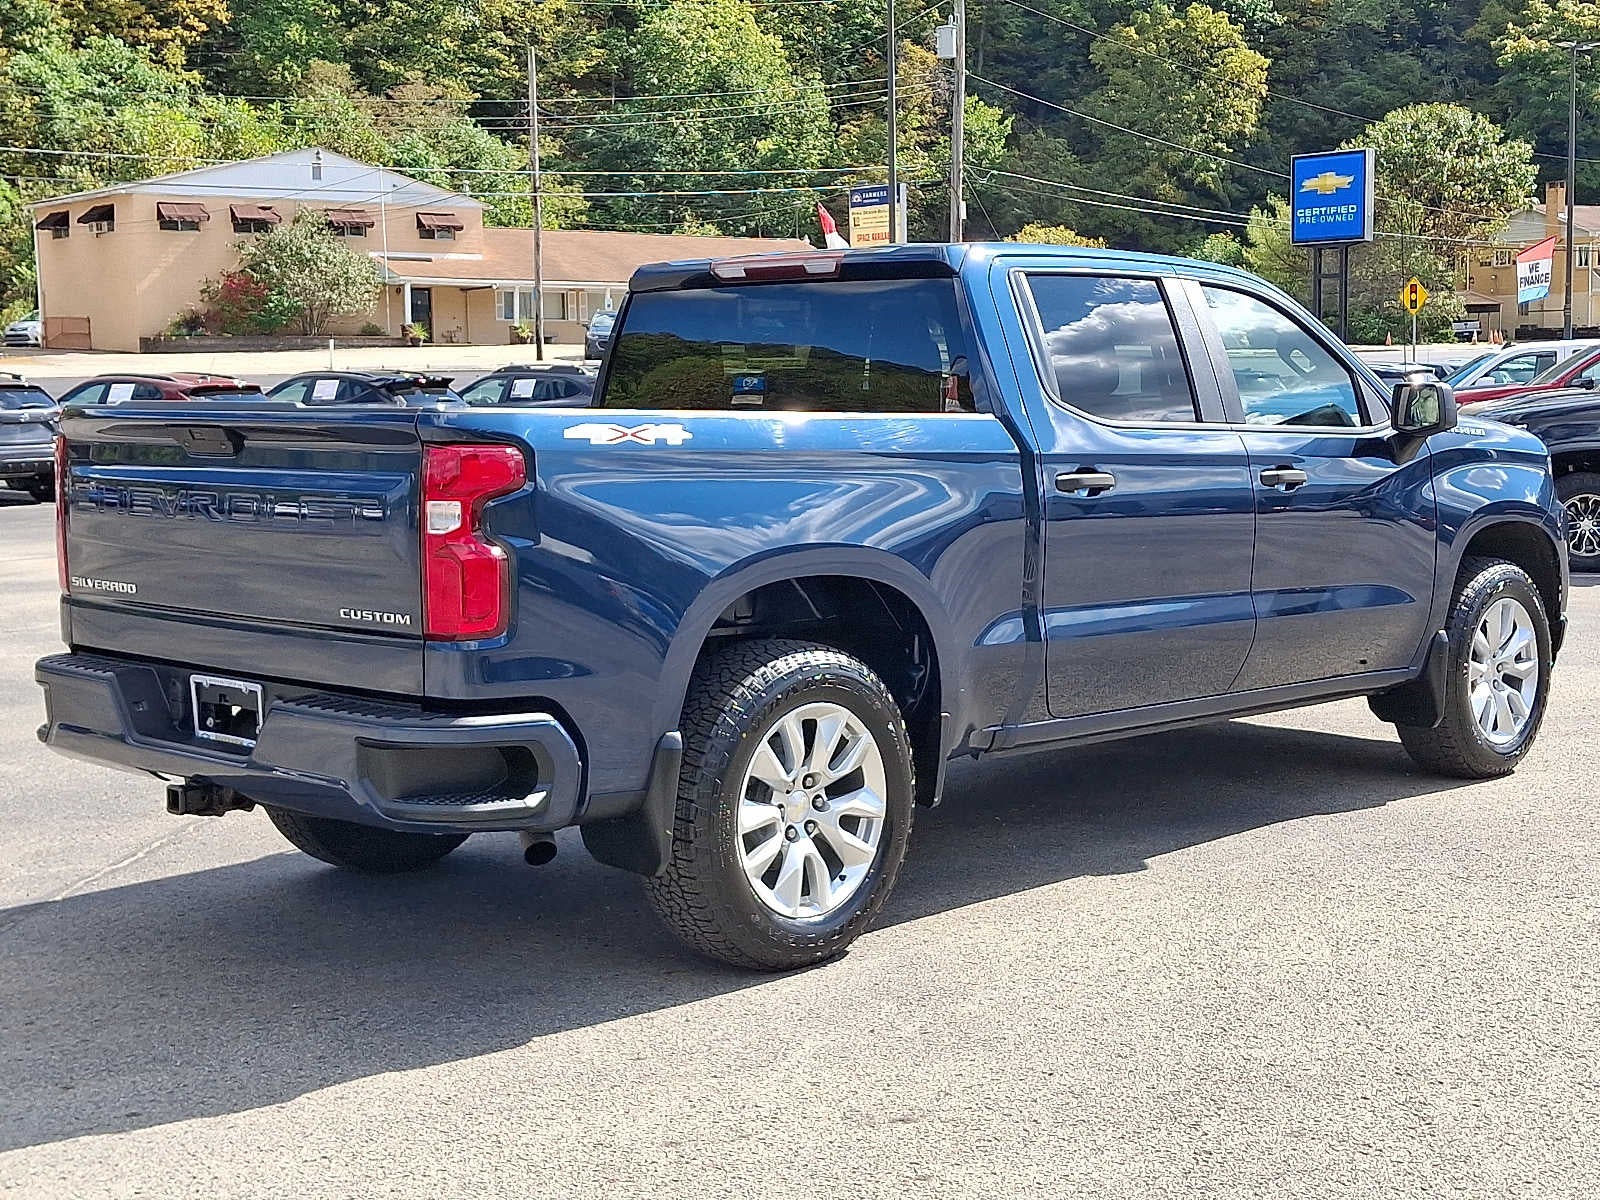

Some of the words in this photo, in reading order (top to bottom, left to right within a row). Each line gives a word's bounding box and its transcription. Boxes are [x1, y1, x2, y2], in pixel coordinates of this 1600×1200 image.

[1296, 204, 1357, 217] CERTIFIED
[1299, 213, 1354, 225] PRE-OWNED
[1528, 262, 1540, 274] WE
[1519, 272, 1550, 289] FINANCE
[73, 482, 388, 528] CHEVROLET
[71, 576, 137, 594] SILVERADO
[339, 608, 411, 625] CUSTOM
